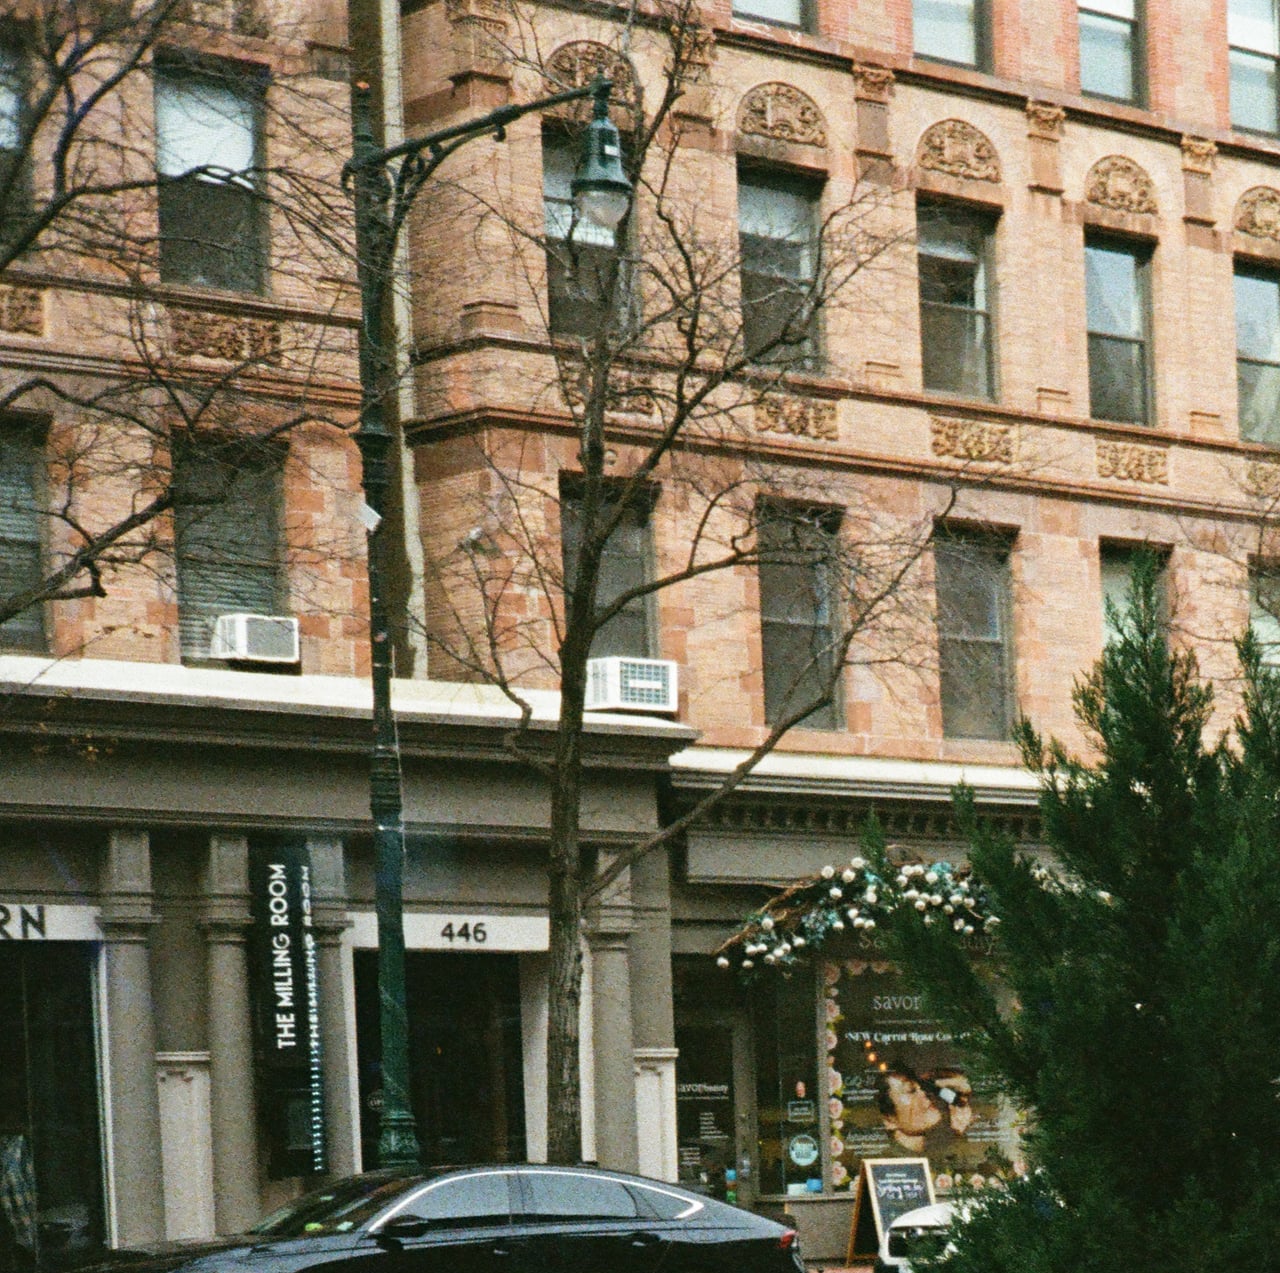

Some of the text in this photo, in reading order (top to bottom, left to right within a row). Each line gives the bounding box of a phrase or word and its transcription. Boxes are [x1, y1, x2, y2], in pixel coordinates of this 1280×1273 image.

[440, 921, 488, 943] 446
[268, 863, 296, 1049] THE MILLING ROOM
[872, 994, 922, 1010] savor
